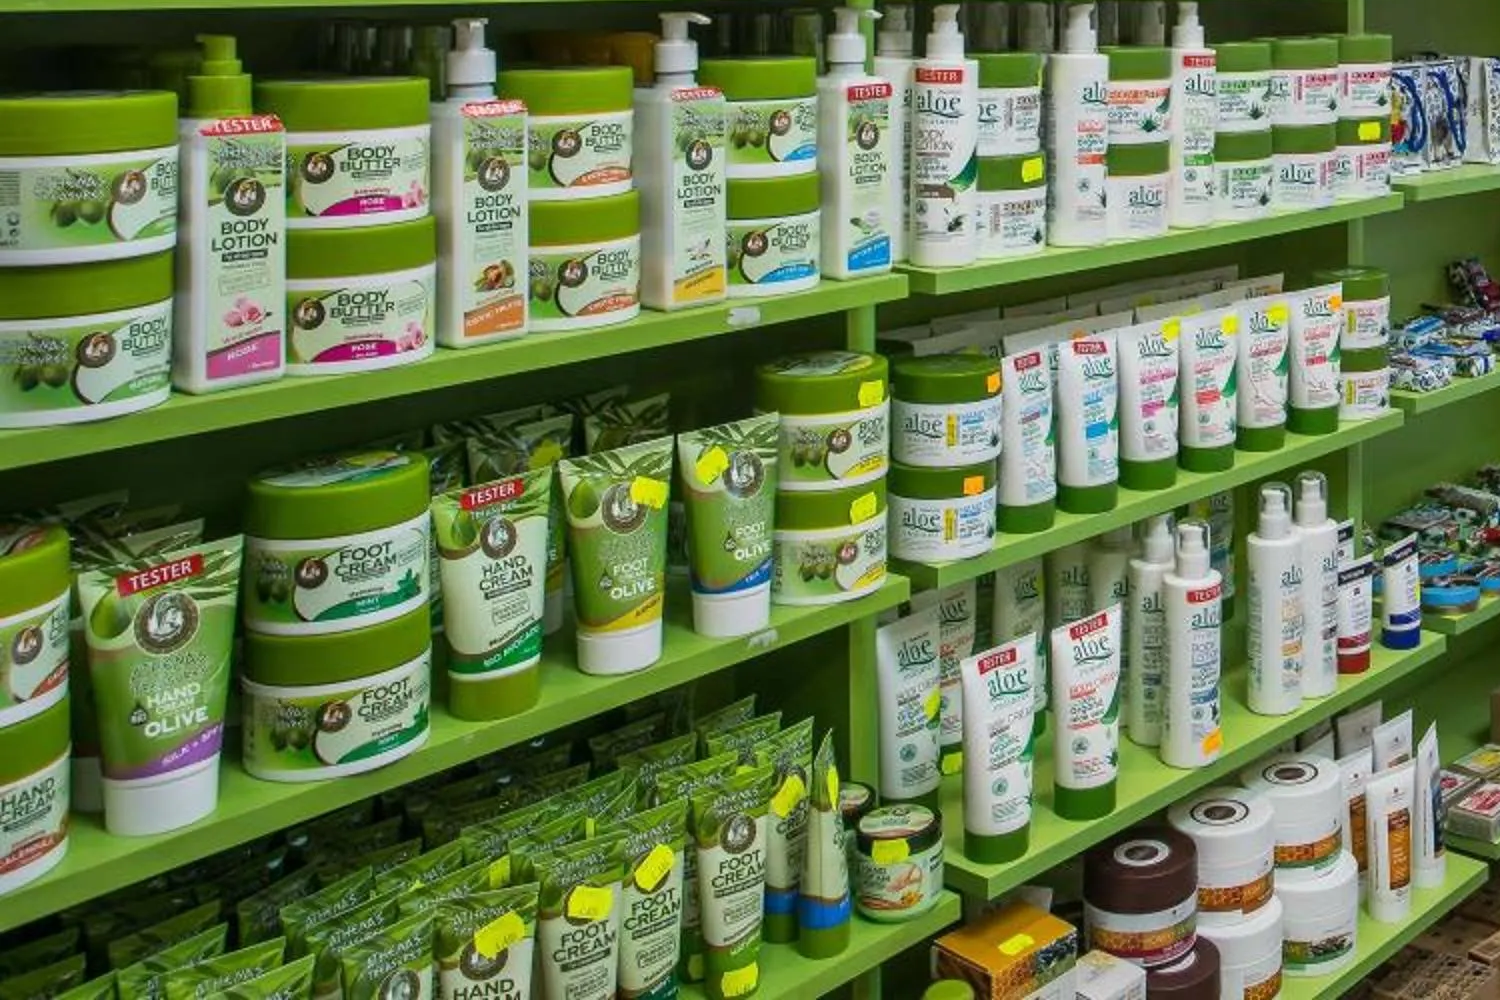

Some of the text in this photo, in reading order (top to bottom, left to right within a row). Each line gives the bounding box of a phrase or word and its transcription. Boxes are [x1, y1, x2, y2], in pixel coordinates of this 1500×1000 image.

[919, 70, 958, 82] TESTER
[855, 84, 889, 99] TESTER
[916, 89, 962, 112] aloe
[212, 117, 273, 134] TESTER
[346, 145, 395, 161] BODY
[853, 152, 882, 165] BODY
[339, 158, 400, 172] BUTTER
[848, 162, 888, 176] LOTION
[1278, 164, 1316, 179] aloe
[683, 173, 715, 186] BODY
[474, 194, 514, 209] BODY
[677, 184, 722, 199] LOTION
[1129, 186, 1161, 204] aloe
[466, 206, 521, 223] LOTION
[220, 218, 269, 237] BODY
[776, 223, 809, 238] BODY
[211, 234, 278, 253] LOTION
[597, 250, 631, 267] BODY
[337, 290, 389, 306] BODY
[330, 301, 395, 318] BUTTER
[1138, 334, 1169, 352] aloe
[1196, 328, 1222, 345] aloe
[1081, 356, 1114, 377] aloe
[904, 413, 942, 433] aloe
[469, 482, 517, 504] TESTER
[903, 508, 940, 526] aloe
[735, 520, 766, 538] FOOT
[339, 540, 394, 563] FOOT
[734, 542, 771, 560] OLIVE
[128, 560, 193, 589] TESTER
[334, 554, 397, 577] CREAM
[481, 556, 527, 578] HAND
[612, 558, 649, 578] FOOT
[479, 567, 534, 591] CREAM
[610, 579, 655, 600] OLIVE
[897, 638, 932, 661] aloe
[1073, 635, 1110, 660] aloe
[362, 677, 411, 703] FOOT
[987, 667, 1028, 693] aloe
[146, 684, 201, 708] HAND
[357, 694, 414, 717] CREAM
[144, 706, 209, 738] OLIVE
[0, 777, 55, 809] HAND
[719, 851, 760, 875] FOOT
[711, 862, 765, 889] CREAM
[631, 888, 676, 913] FOOT
[623, 900, 681, 930] CREAM
[561, 920, 609, 946] FOOT
[552, 931, 617, 963] CREAM
[453, 979, 515, 999] HAND
